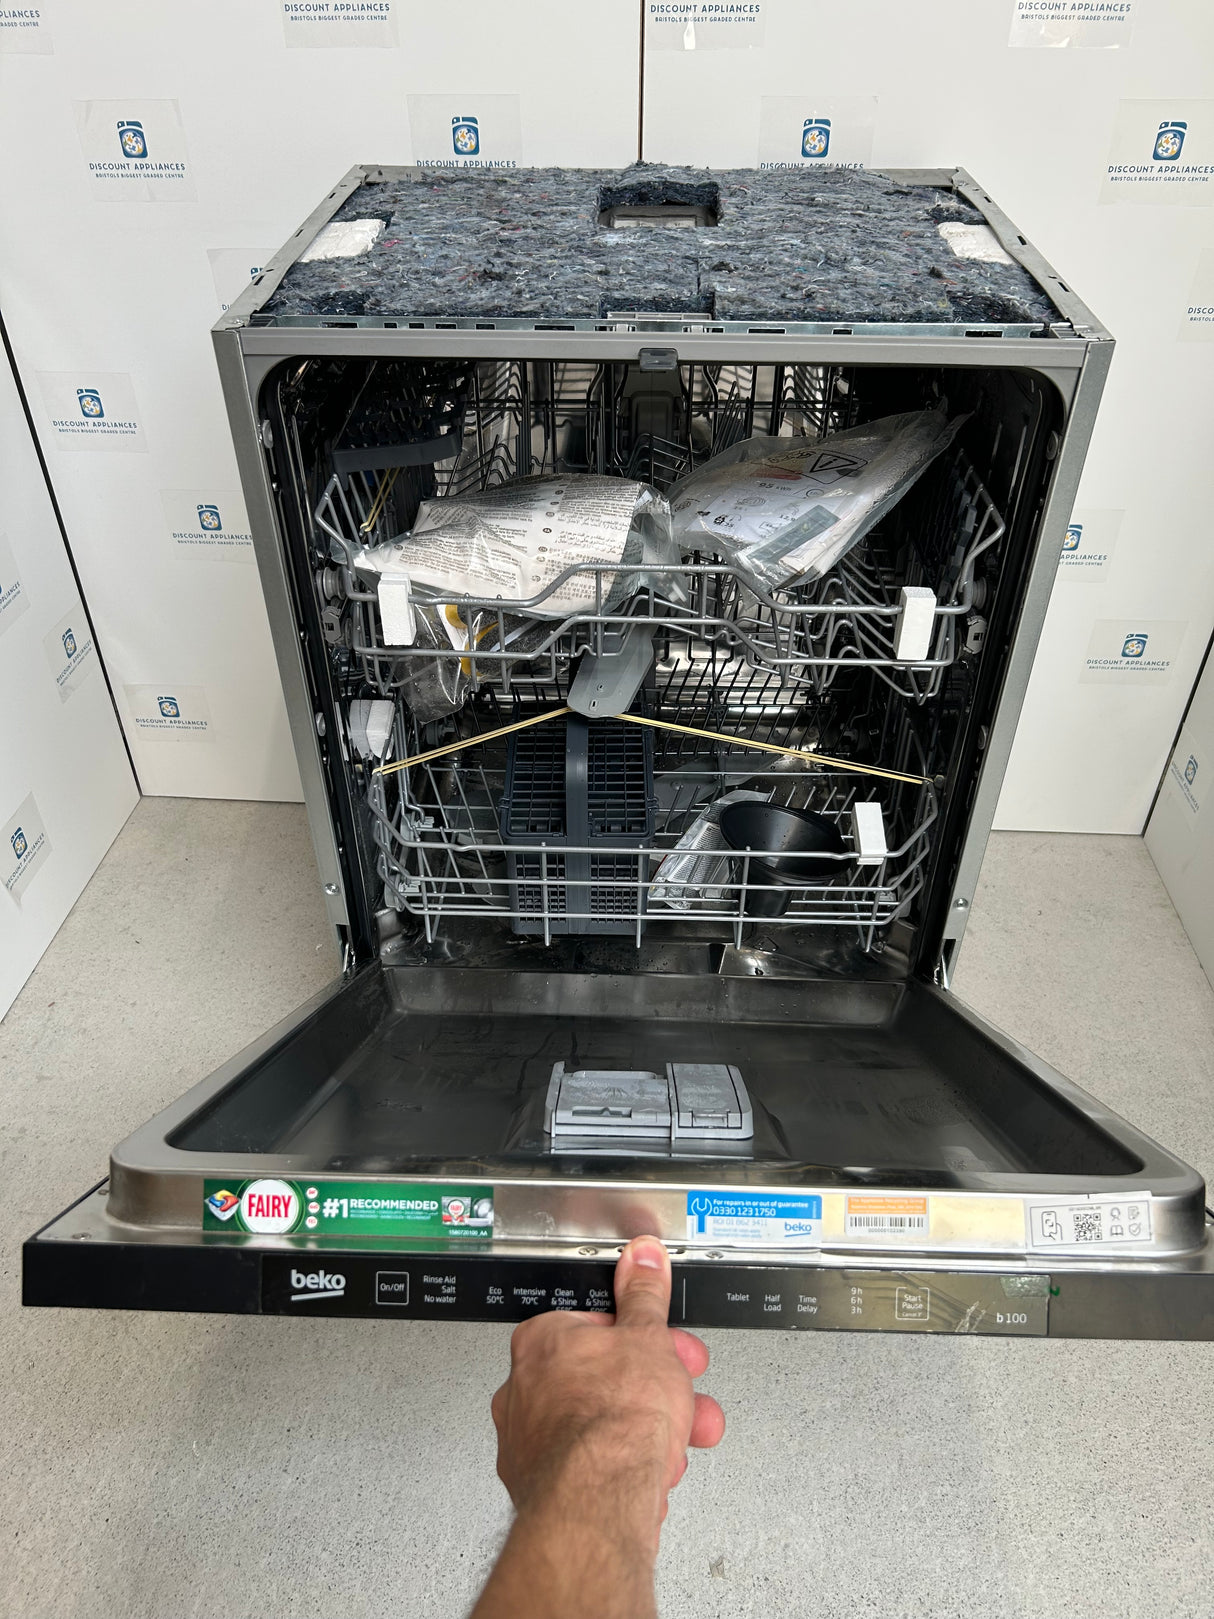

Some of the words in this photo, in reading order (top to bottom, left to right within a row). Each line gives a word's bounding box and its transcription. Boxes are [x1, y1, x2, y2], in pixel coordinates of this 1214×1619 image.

[284, 3, 330, 12] DISCOUNT
[333, 3, 390, 12] APPLIANCES
[650, 4, 698, 13] DISCOUNT
[701, 4, 760, 13] APPLIANCES
[1018, 2, 1067, 11] DISCOUNT
[1070, 2, 1131, 12] APPLIANCES
[89, 162, 130, 170] DISCOUNT
[134, 162, 186, 171] APPLIANCES
[463, 160, 517, 168] APPLIANCES
[1107, 165, 1155, 173] DISCOUNT
[1157, 165, 1214, 174] APPLIANCES
[92, 421, 138, 429] APPLIANCES
[248, 1193, 293, 1218] FAIRY
[322, 1198, 349, 1218] #1
[350, 1198, 439, 1210] RECOMMENDED
[713, 1206, 736, 1214] 0330
[737, 1207, 753, 1216] 123
[754, 1208, 776, 1216] 1750
[784, 1221, 812, 1232] beko
[290, 1269, 346, 1290] beko
[423, 1275, 444, 1284] Rinse
[444, 1275, 457, 1284] Aid
[380, 1283, 405, 1292] On/Off
[441, 1285, 456, 1293] Salt
[488, 1286, 503, 1295] Eco
[513, 1287, 547, 1296] Intensive
[554, 1288, 574, 1297] Clean
[589, 1289, 609, 1299] Quick
[726, 1292, 750, 1301] Tablet
[424, 1294, 435, 1303] No
[435, 1295, 457, 1303] water
[551, 1297, 559, 1305] &
[559, 1297, 578, 1306] Shine
[585, 1298, 593, 1306] &
[764, 1294, 781, 1302] Half
[798, 1295, 817, 1303] Time
[904, 1293, 922, 1302] Start
[763, 1303, 782, 1311] Load
[797, 1304, 818, 1315] Delay
[901, 1302, 923, 1310] Pause
